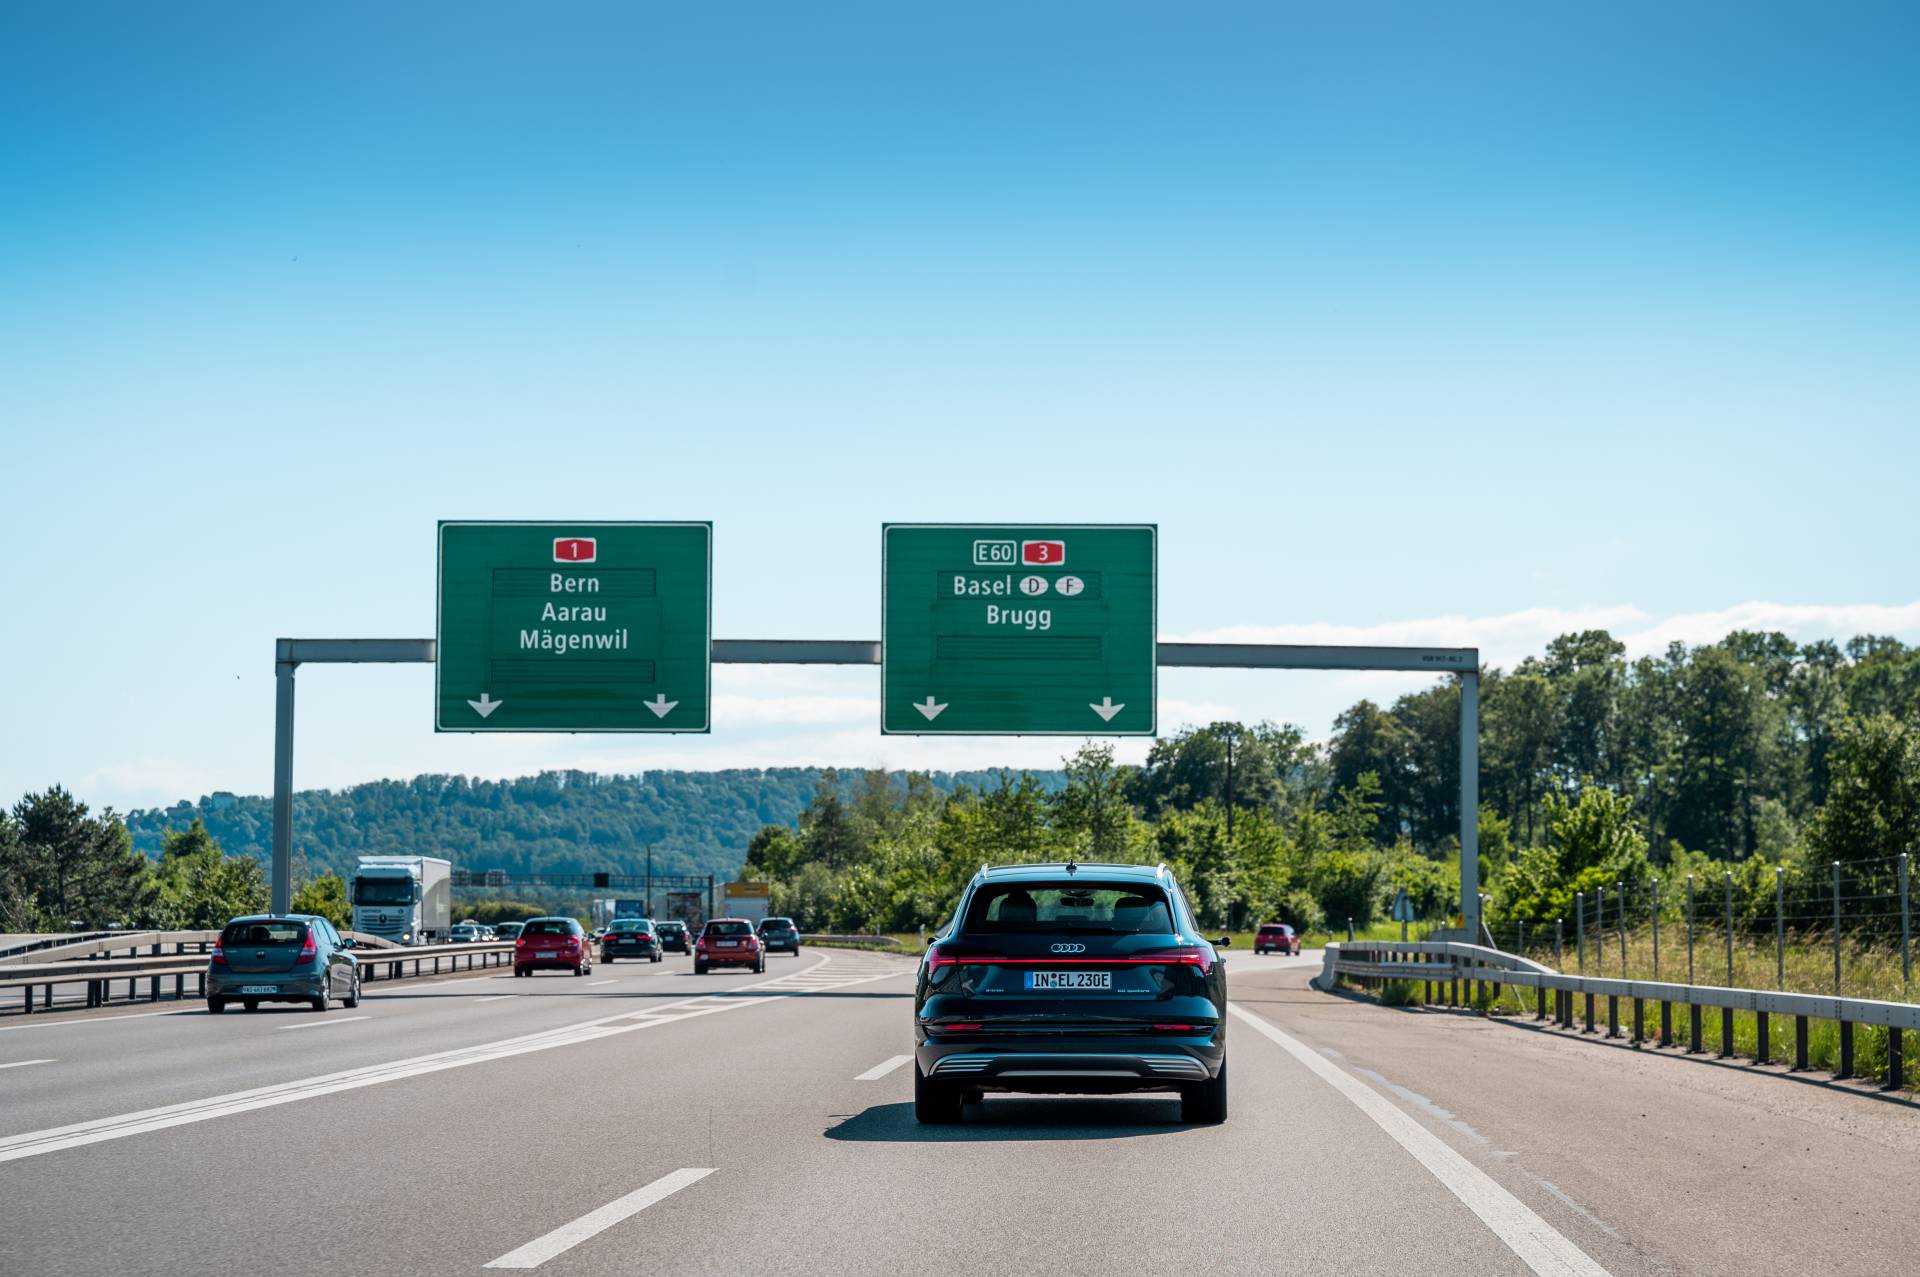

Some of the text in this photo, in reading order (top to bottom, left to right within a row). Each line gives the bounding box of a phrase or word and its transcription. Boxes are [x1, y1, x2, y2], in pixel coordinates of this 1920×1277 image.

[571, 542, 578, 558] 1
[1039, 545, 1049, 560] 3
[550, 573, 600, 593] Bern
[953, 575, 1074, 595] Basel D F
[541, 602, 607, 622] Aarau
[987, 605, 1051, 630] Brugg
[520, 629, 628, 655] Mägenwil
[1034, 973, 1109, 987] IN EL 230E
